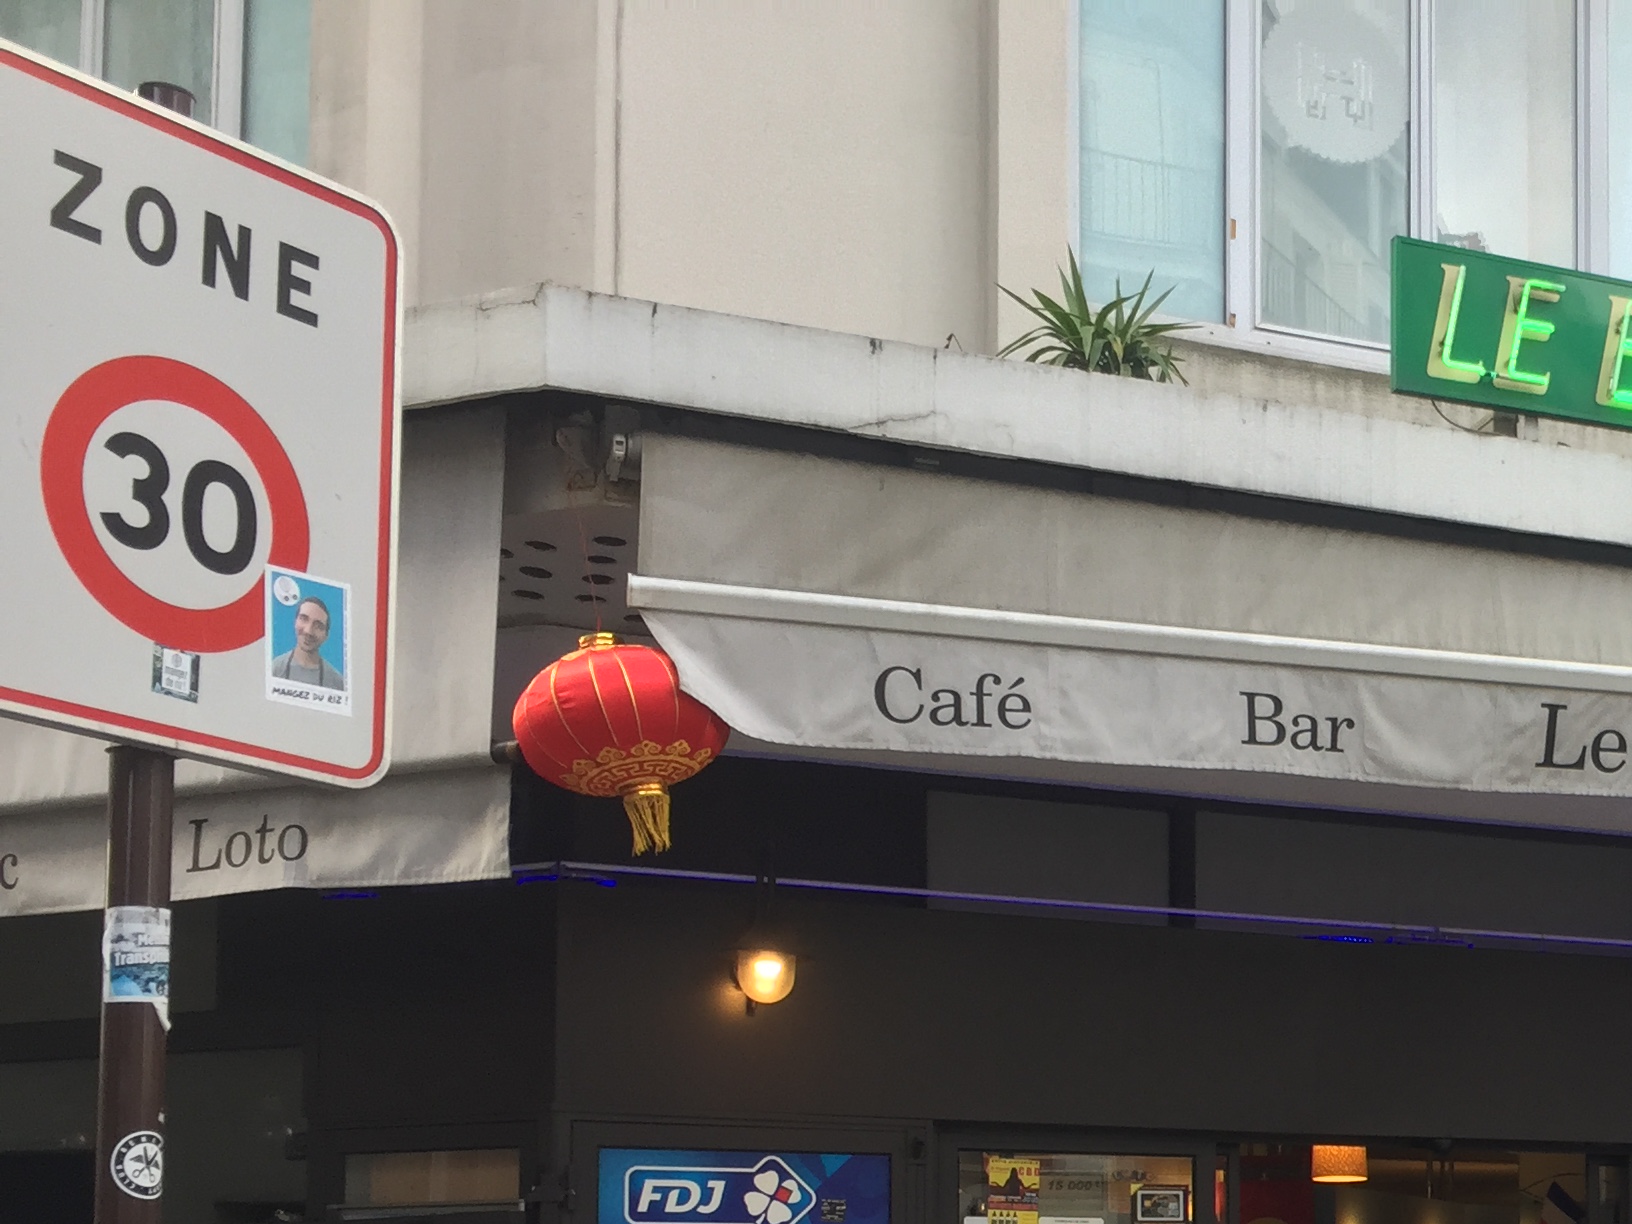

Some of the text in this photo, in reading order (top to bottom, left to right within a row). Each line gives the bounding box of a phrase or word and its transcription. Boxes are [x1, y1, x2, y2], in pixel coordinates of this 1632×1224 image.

[49, 148, 321, 328] ZONE
[1425, 262, 1566, 397] LE
[99, 430, 258, 576] 30
[271, 686, 310, 701] MANGEZ
[312, 692, 324, 702] DU
[873, 665, 1033, 731] Café
[1238, 690, 1356, 754] Bar
[1533, 702, 1628, 774] Le
[186, 813, 309, 873] Loto
[636, 1178, 727, 1214] FDJ
